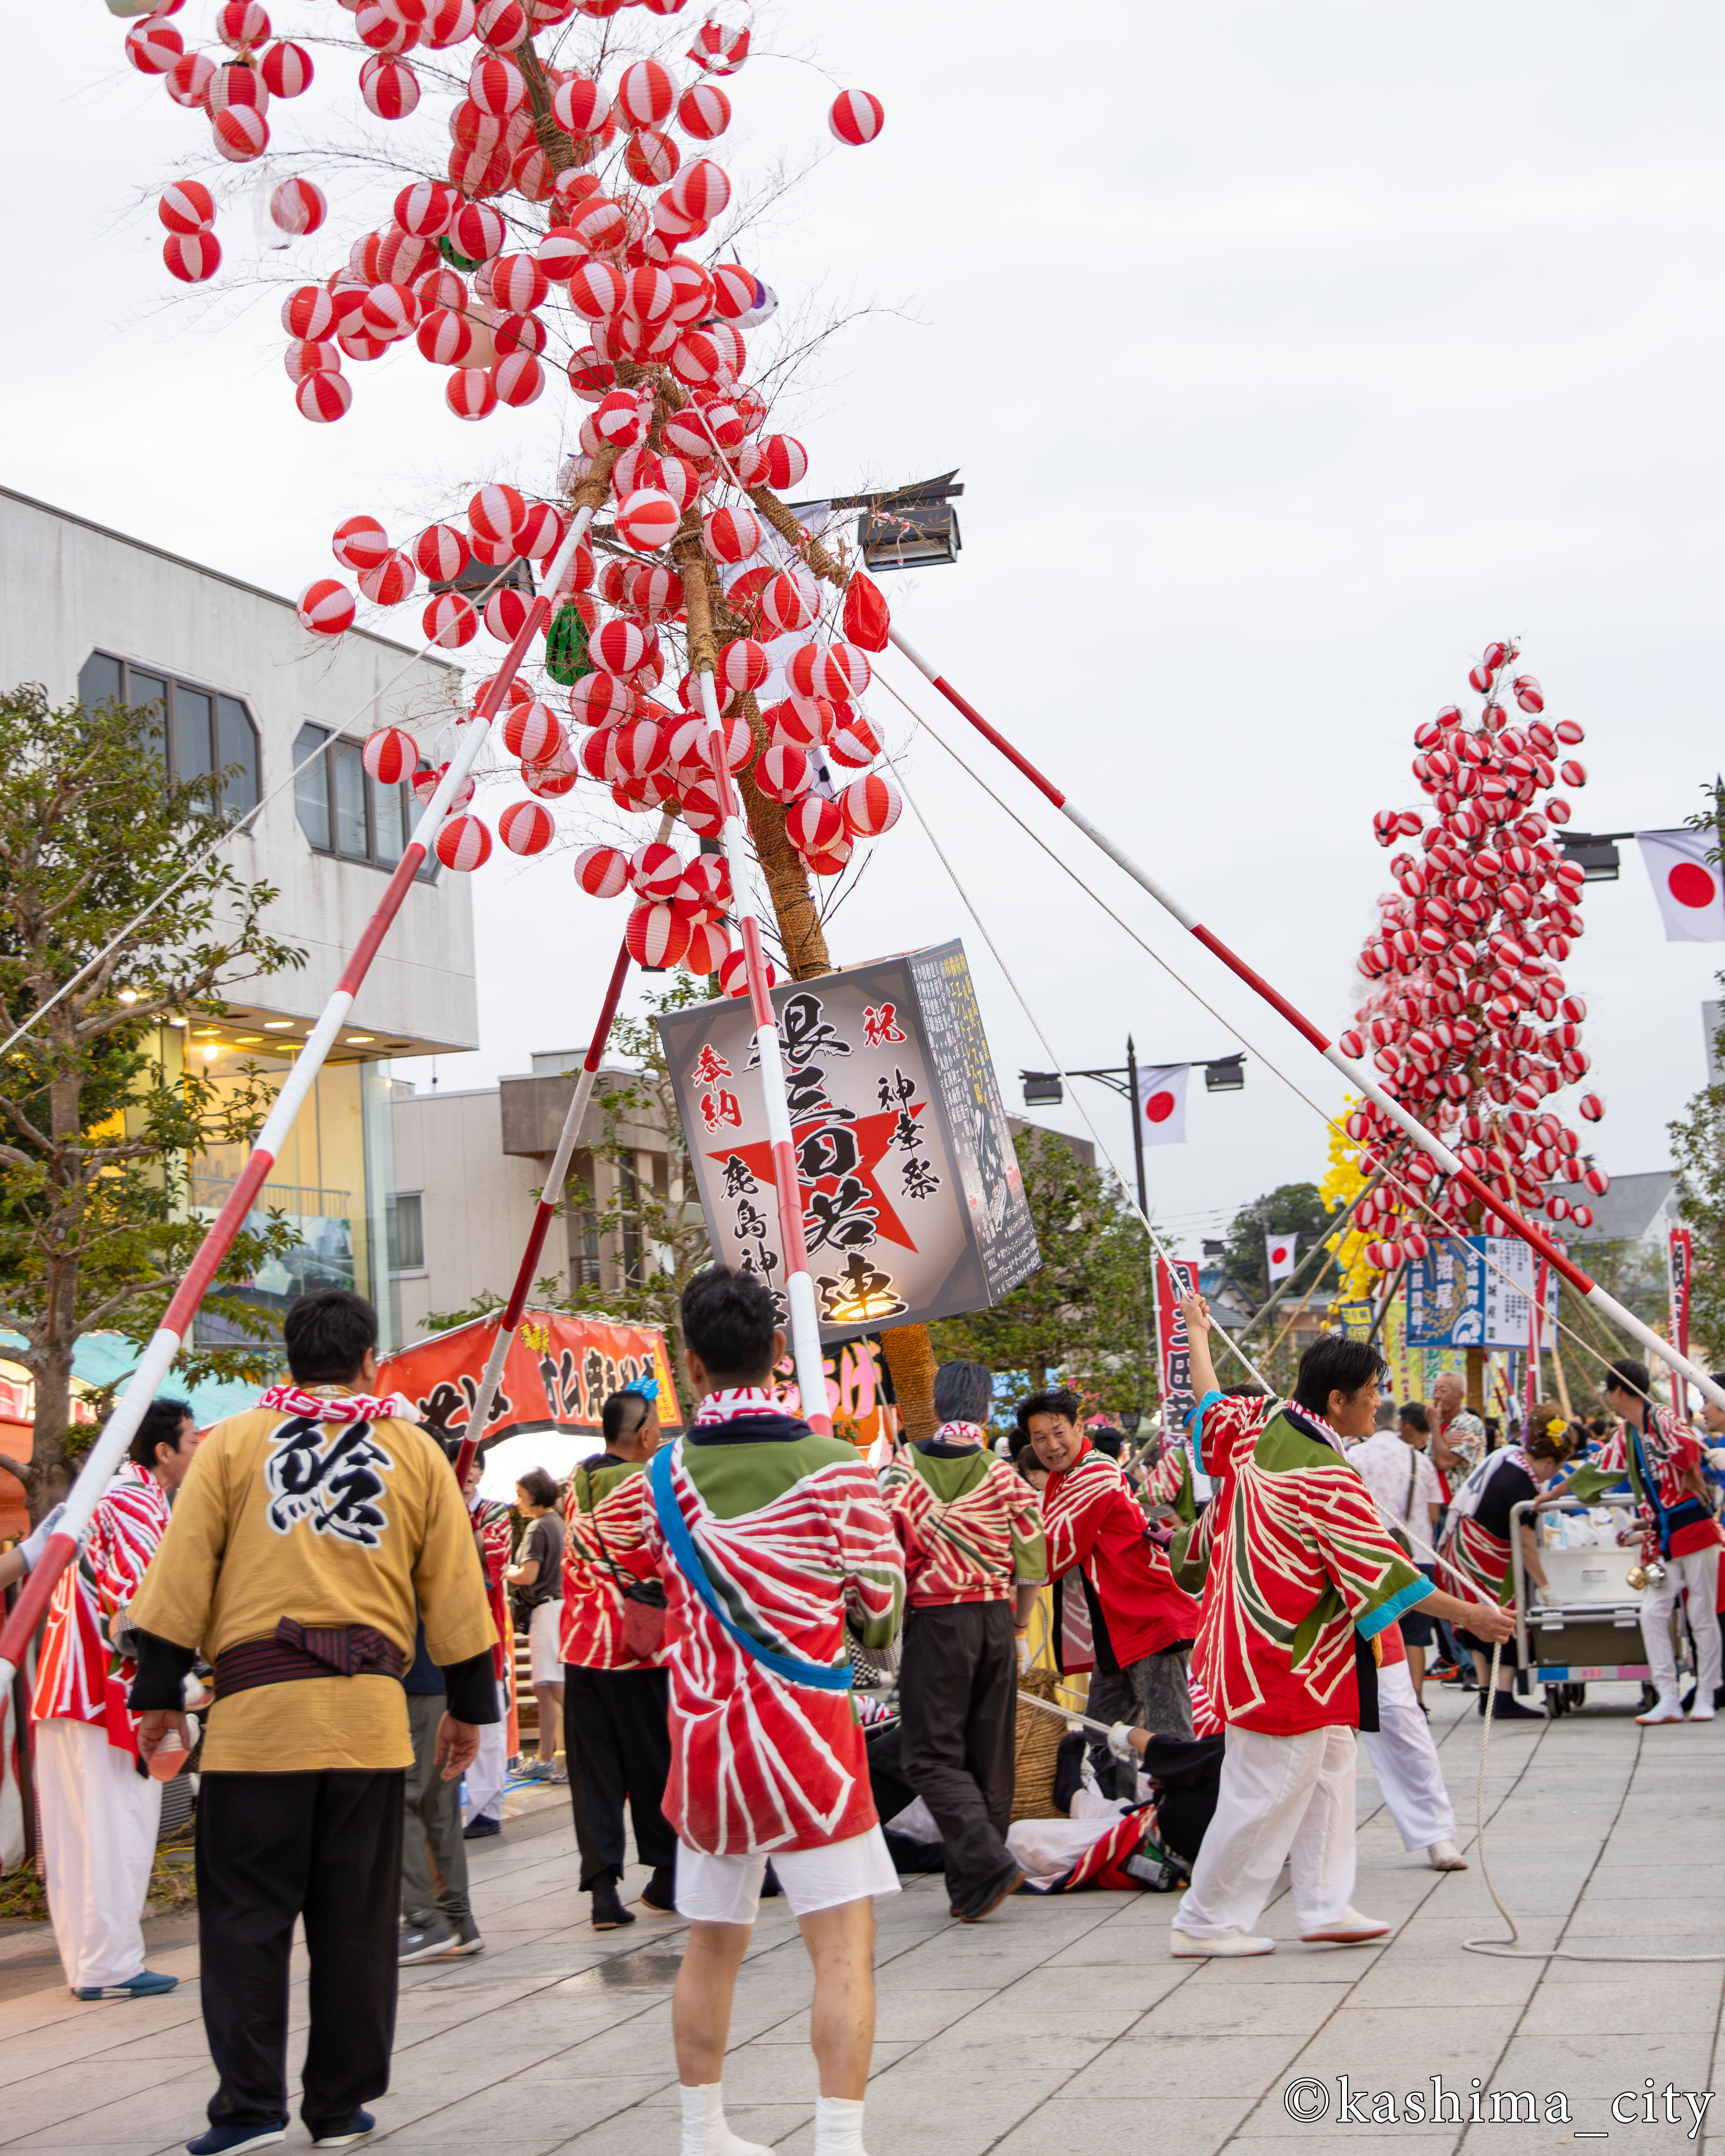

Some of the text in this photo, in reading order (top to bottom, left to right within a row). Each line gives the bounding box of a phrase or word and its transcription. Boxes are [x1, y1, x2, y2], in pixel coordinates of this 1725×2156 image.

[862, 1002, 907, 1048] 祝
[692, 1044, 743, 1134] 奉納
[877, 1064, 942, 1200] 神幸祭
